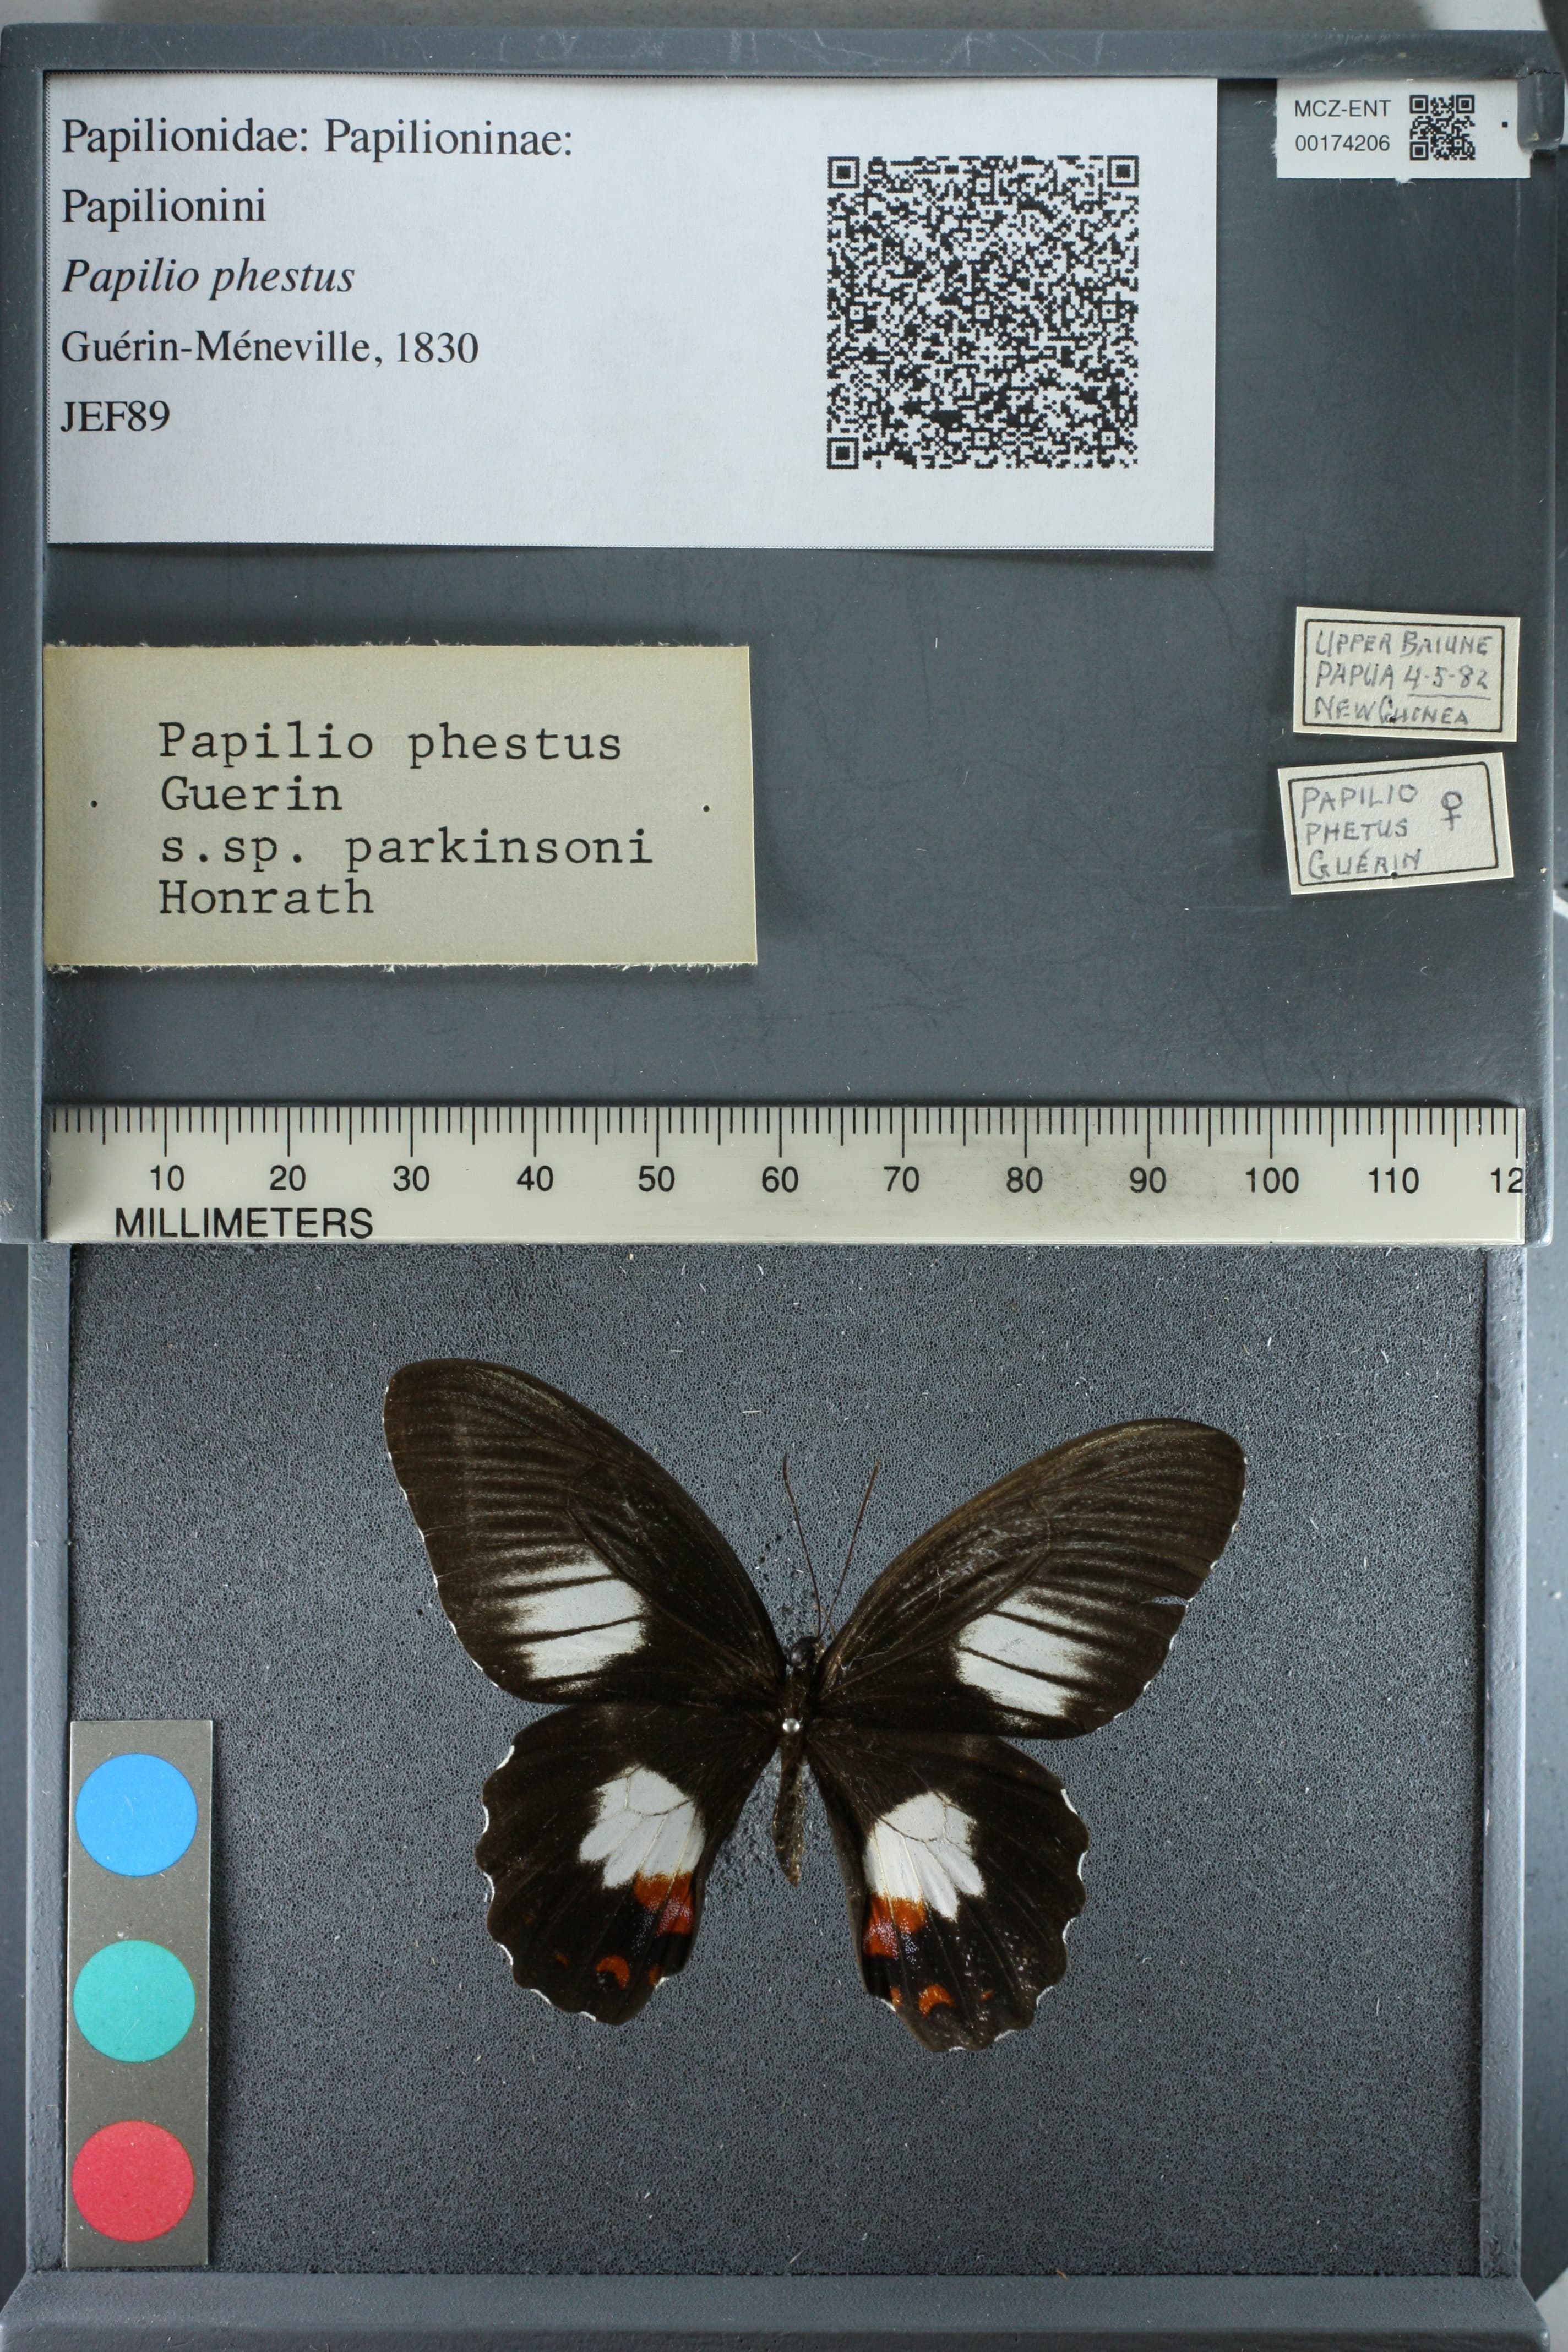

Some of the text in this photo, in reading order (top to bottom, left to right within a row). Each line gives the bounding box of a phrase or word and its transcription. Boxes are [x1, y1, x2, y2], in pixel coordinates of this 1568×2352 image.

[1295, 99, 1391, 117] MCZ-ENT
[62, 117, 571, 163] Papilionidae: Papilioninae:
[1295, 134, 1390, 151] 00174206
[62, 187, 266, 233] Papilionini
[61, 257, 355, 302] Papilio phestus
[61, 329, 478, 367] Guérin-Méneville, 1830
[60, 400, 170, 432] JEF89
[1315, 630, 1392, 657] UPPER
[1315, 661, 1394, 690] PAPUA
[1314, 695, 1469, 725] NEW GUINEA
[158, 720, 620, 769] Papilio phestus
[161, 775, 342, 811] Guerin
[1302, 784, 1418, 818] PAPILIO
[1306, 819, 1408, 845] PHETUS
[162, 826, 653, 873] s.sp. parkinsoni
[158, 877, 374, 914] Honrath
[150, 1164, 184, 1192] 10
[270, 1164, 306, 1191] 20
[393, 1165, 430, 1192] 30
[516, 1165, 554, 1192] 40
[638, 1165, 675, 1193] 50
[761, 1166, 799, 1193] 60
[883, 1166, 919, 1193] 70
[1006, 1166, 1043, 1194] 80
[1129, 1166, 1167, 1194] 90
[1245, 1167, 1299, 1194] 100
[1368, 1167, 1419, 1194] 110
[116, 1207, 373, 1239] MILLIMETERS
